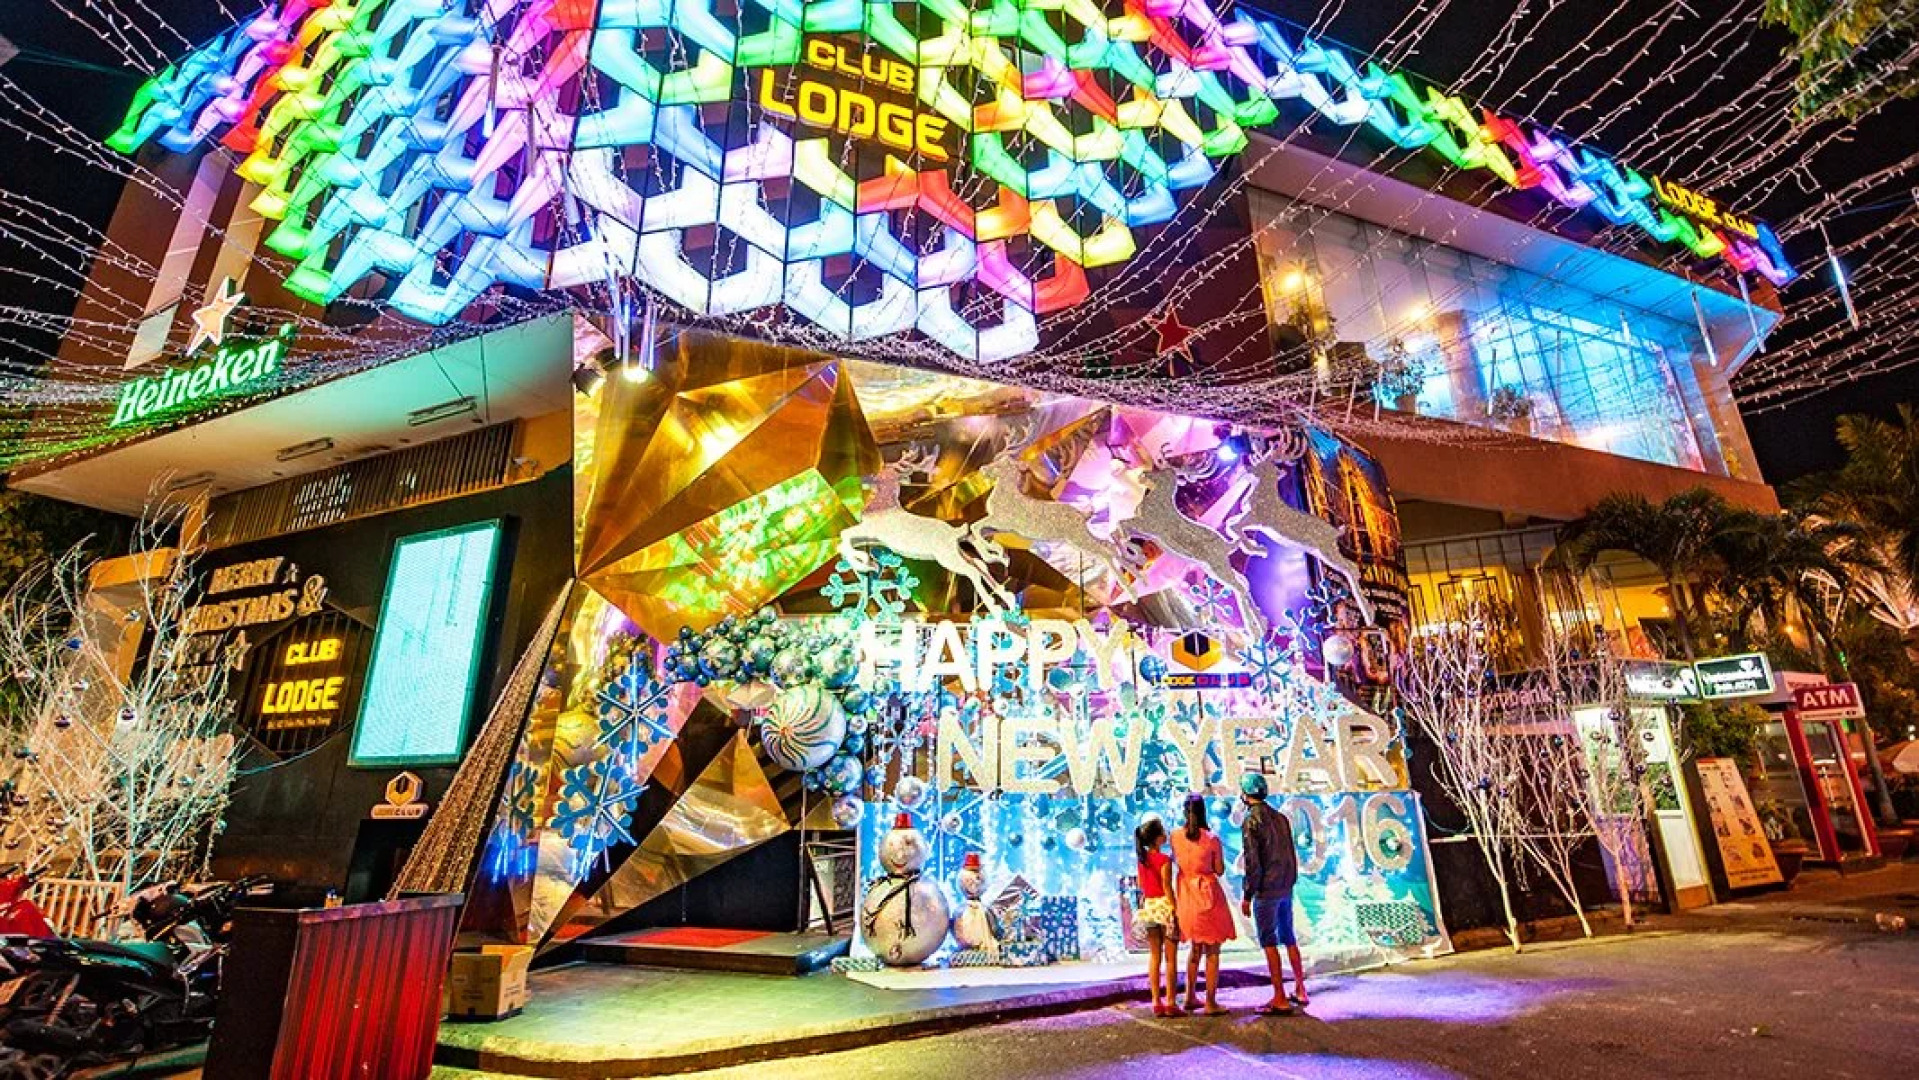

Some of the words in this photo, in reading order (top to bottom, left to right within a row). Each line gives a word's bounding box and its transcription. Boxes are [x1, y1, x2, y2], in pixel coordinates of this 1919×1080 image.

[807, 38, 915, 93] CLUB
[760, 68, 949, 161] LODGE
[110, 340, 280, 429] Heineken
[209, 556, 284, 595] MERRY
[297, 574, 328, 616] &
[284, 638, 341, 665] CLUB
[858, 617, 1132, 692] HAPPY
[262, 677, 345, 713] LODGE
[1803, 688, 1851, 708] ATM
[937, 706, 1149, 796] NEW
[1163, 709, 1400, 793] YEAR
[1232, 794, 1413, 875] 016
